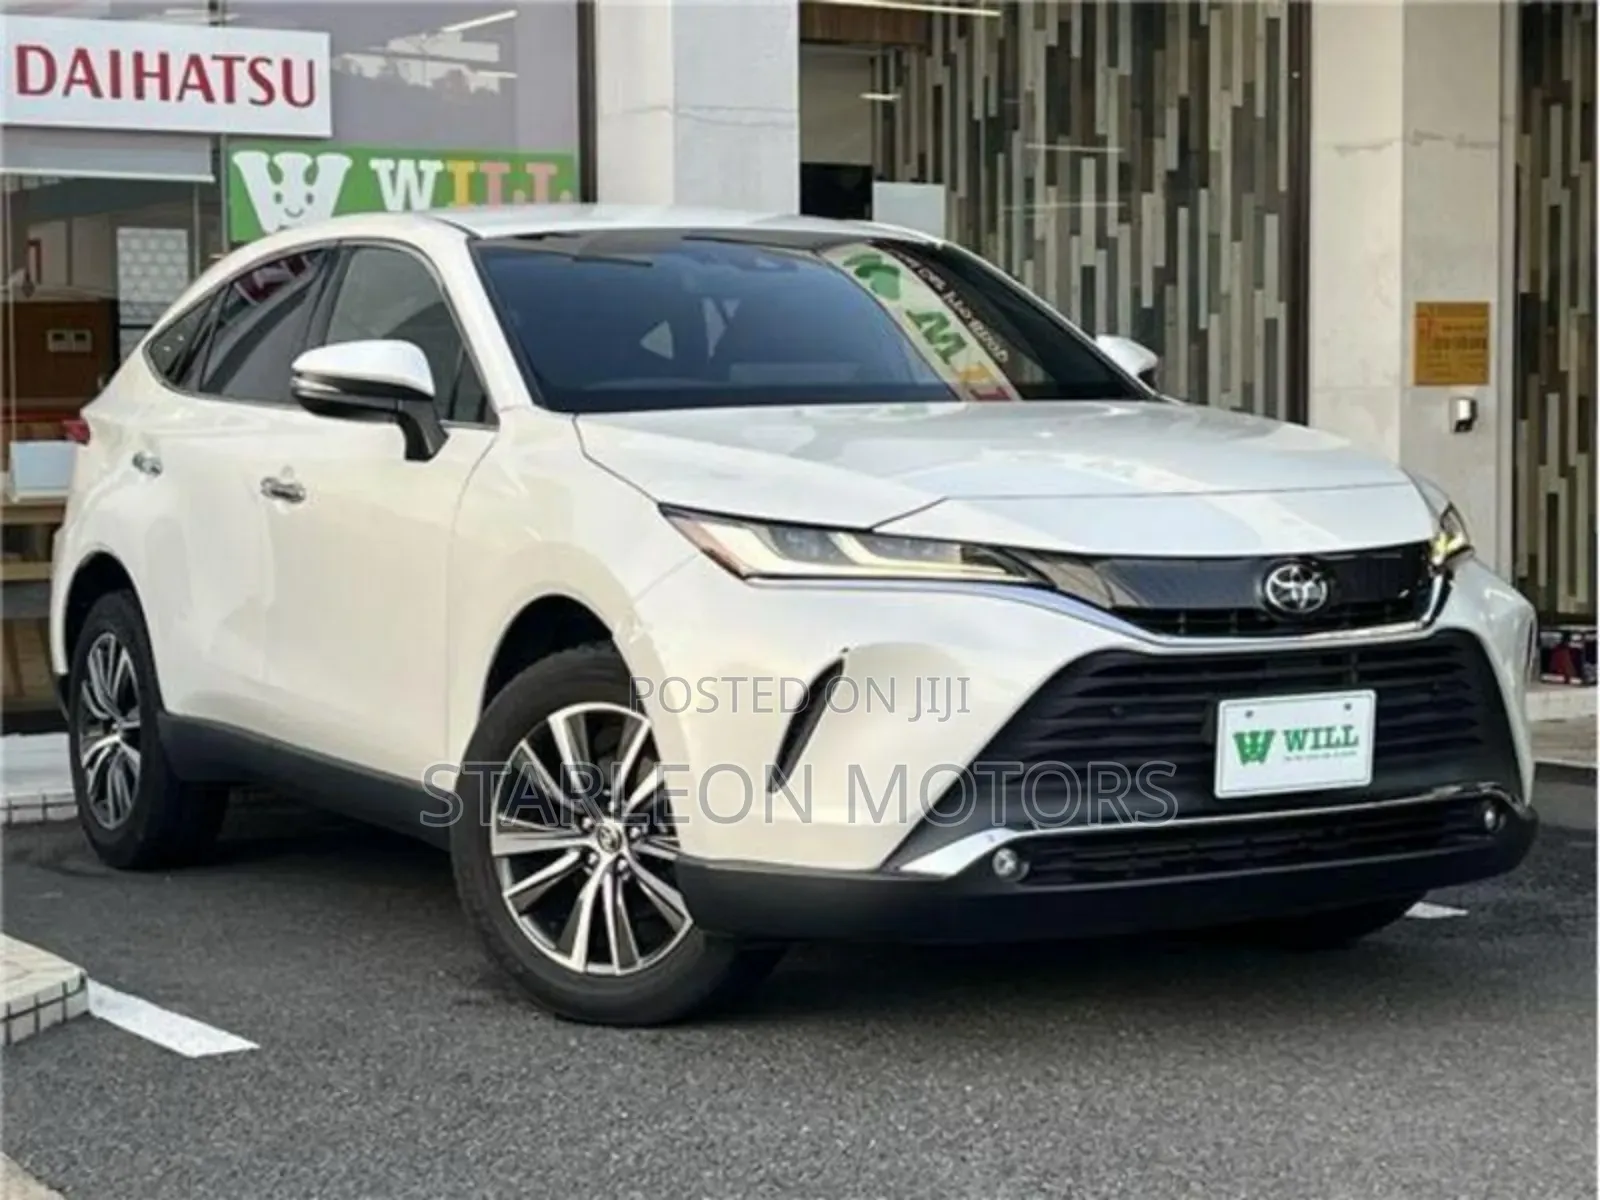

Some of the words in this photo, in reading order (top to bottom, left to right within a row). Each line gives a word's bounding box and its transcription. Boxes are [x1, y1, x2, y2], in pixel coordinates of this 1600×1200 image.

[15, 44, 315, 108] DAIHATSU
[369, 158, 574, 212] WILL
[1283, 725, 1360, 753] WILL
